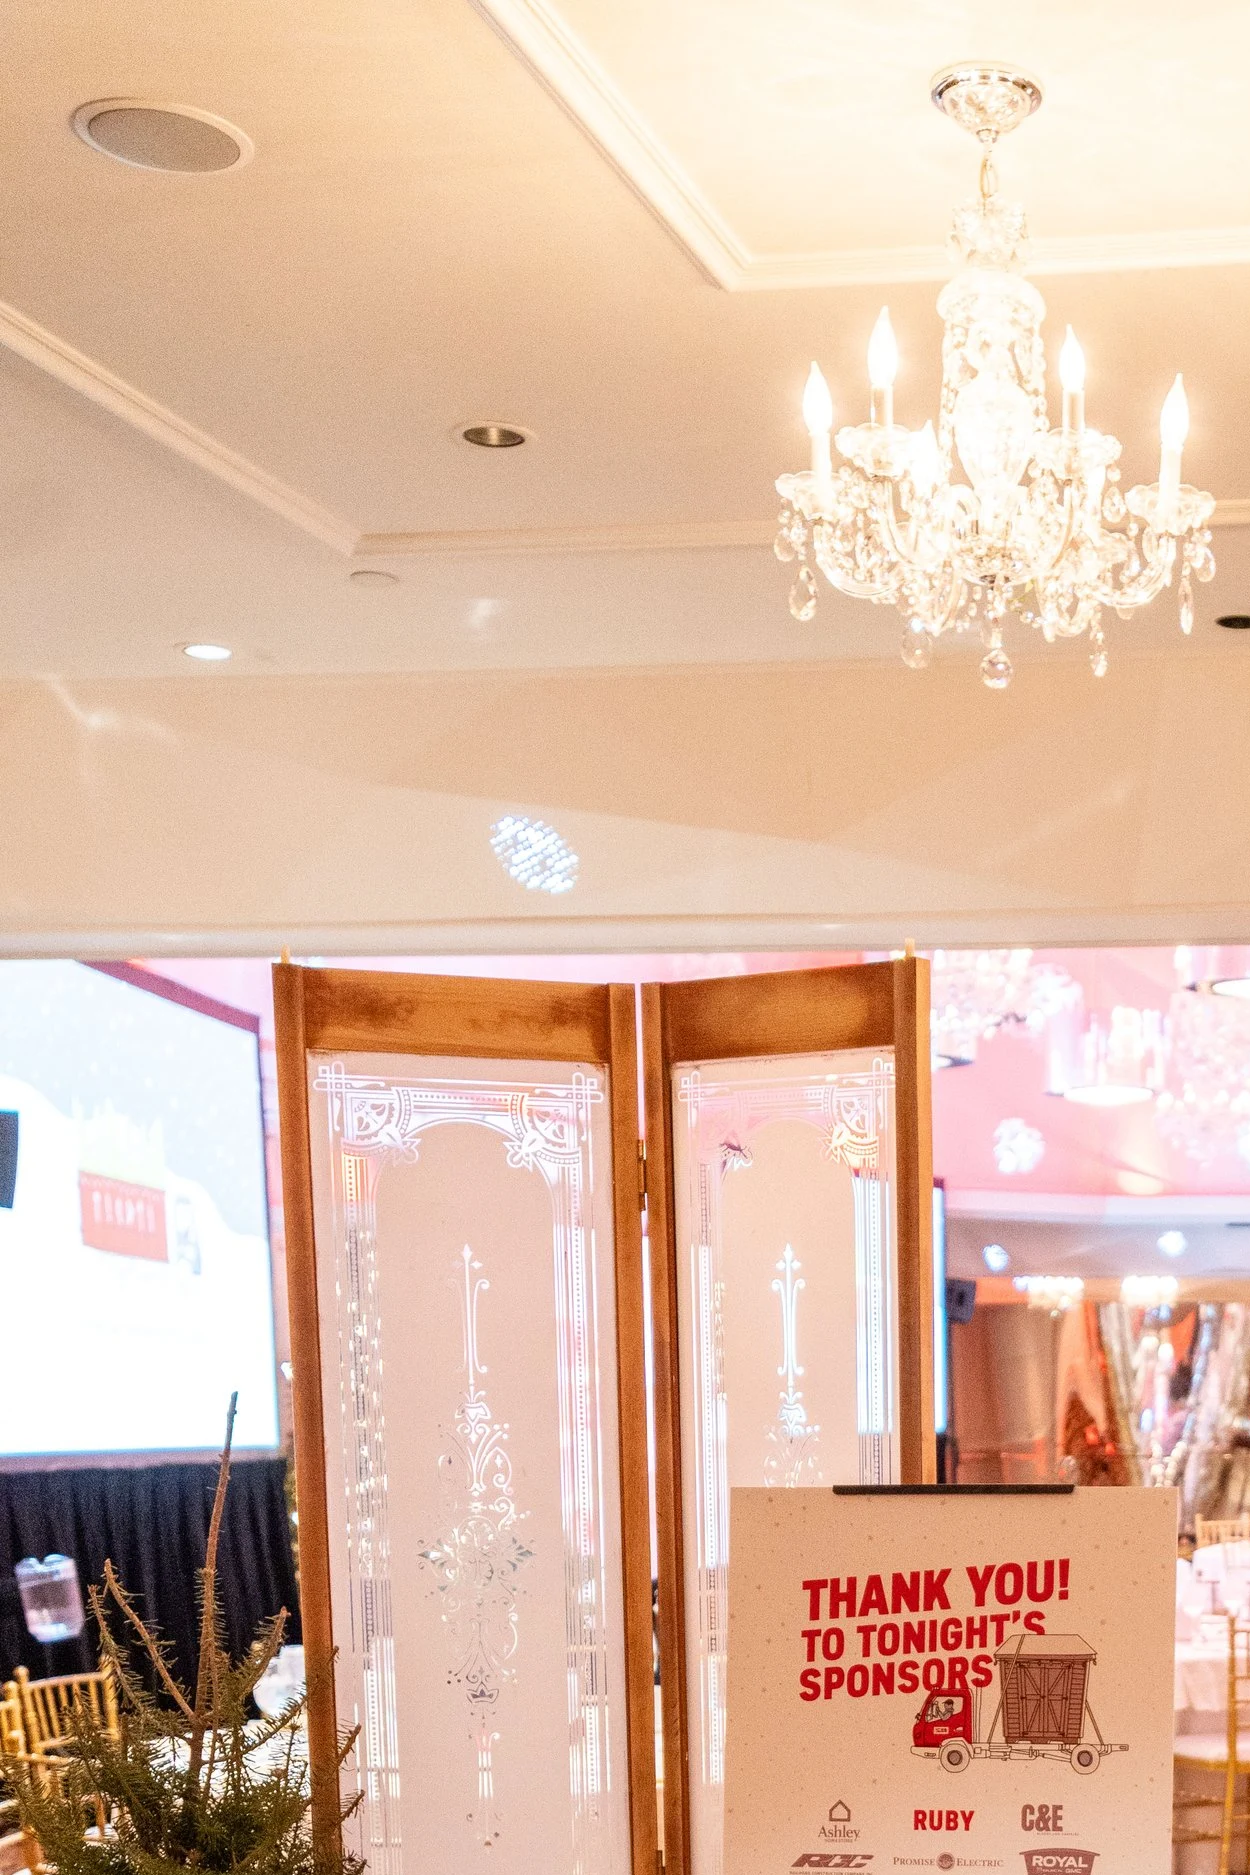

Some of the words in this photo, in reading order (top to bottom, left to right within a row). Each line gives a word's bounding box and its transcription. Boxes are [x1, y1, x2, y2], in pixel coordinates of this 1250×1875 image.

[802, 1568, 952, 1621] THANK
[967, 1558, 1070, 1606] YOU!
[801, 1628, 844, 1663] TO
[857, 1610, 1045, 1659] TONIGHT'S
[800, 1653, 993, 1701] SPONSORS
[913, 1809, 975, 1832] RUBY
[1021, 1804, 1064, 1832] C&E
[818, 1825, 860, 1841] Ashley
[893, 1857, 936, 1866] PROMISE
[1032, 1855, 1088, 1868] ROYAL
